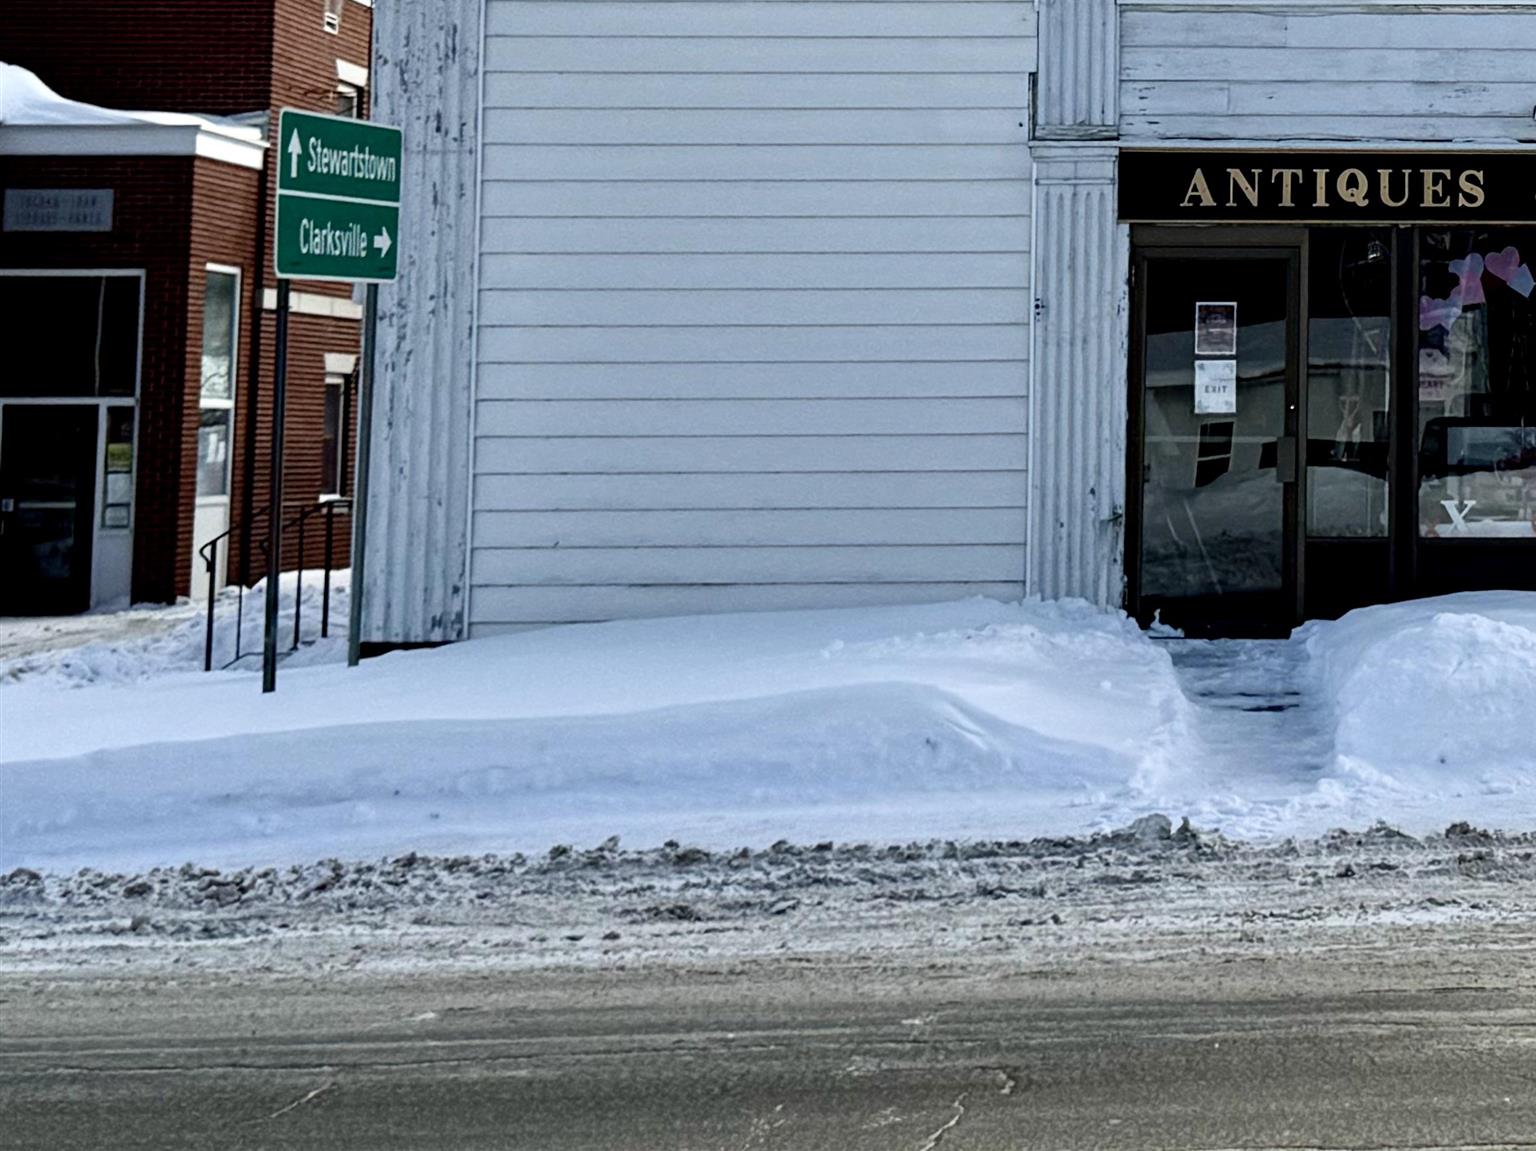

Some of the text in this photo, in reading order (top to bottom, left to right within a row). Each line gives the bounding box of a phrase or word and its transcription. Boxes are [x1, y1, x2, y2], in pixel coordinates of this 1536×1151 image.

[308, 136, 396, 182] Stewartstown
[1180, 168, 1486, 208] ANTIQUES
[299, 218, 368, 257] Clarksville
[1204, 384, 1229, 394] EXIT
